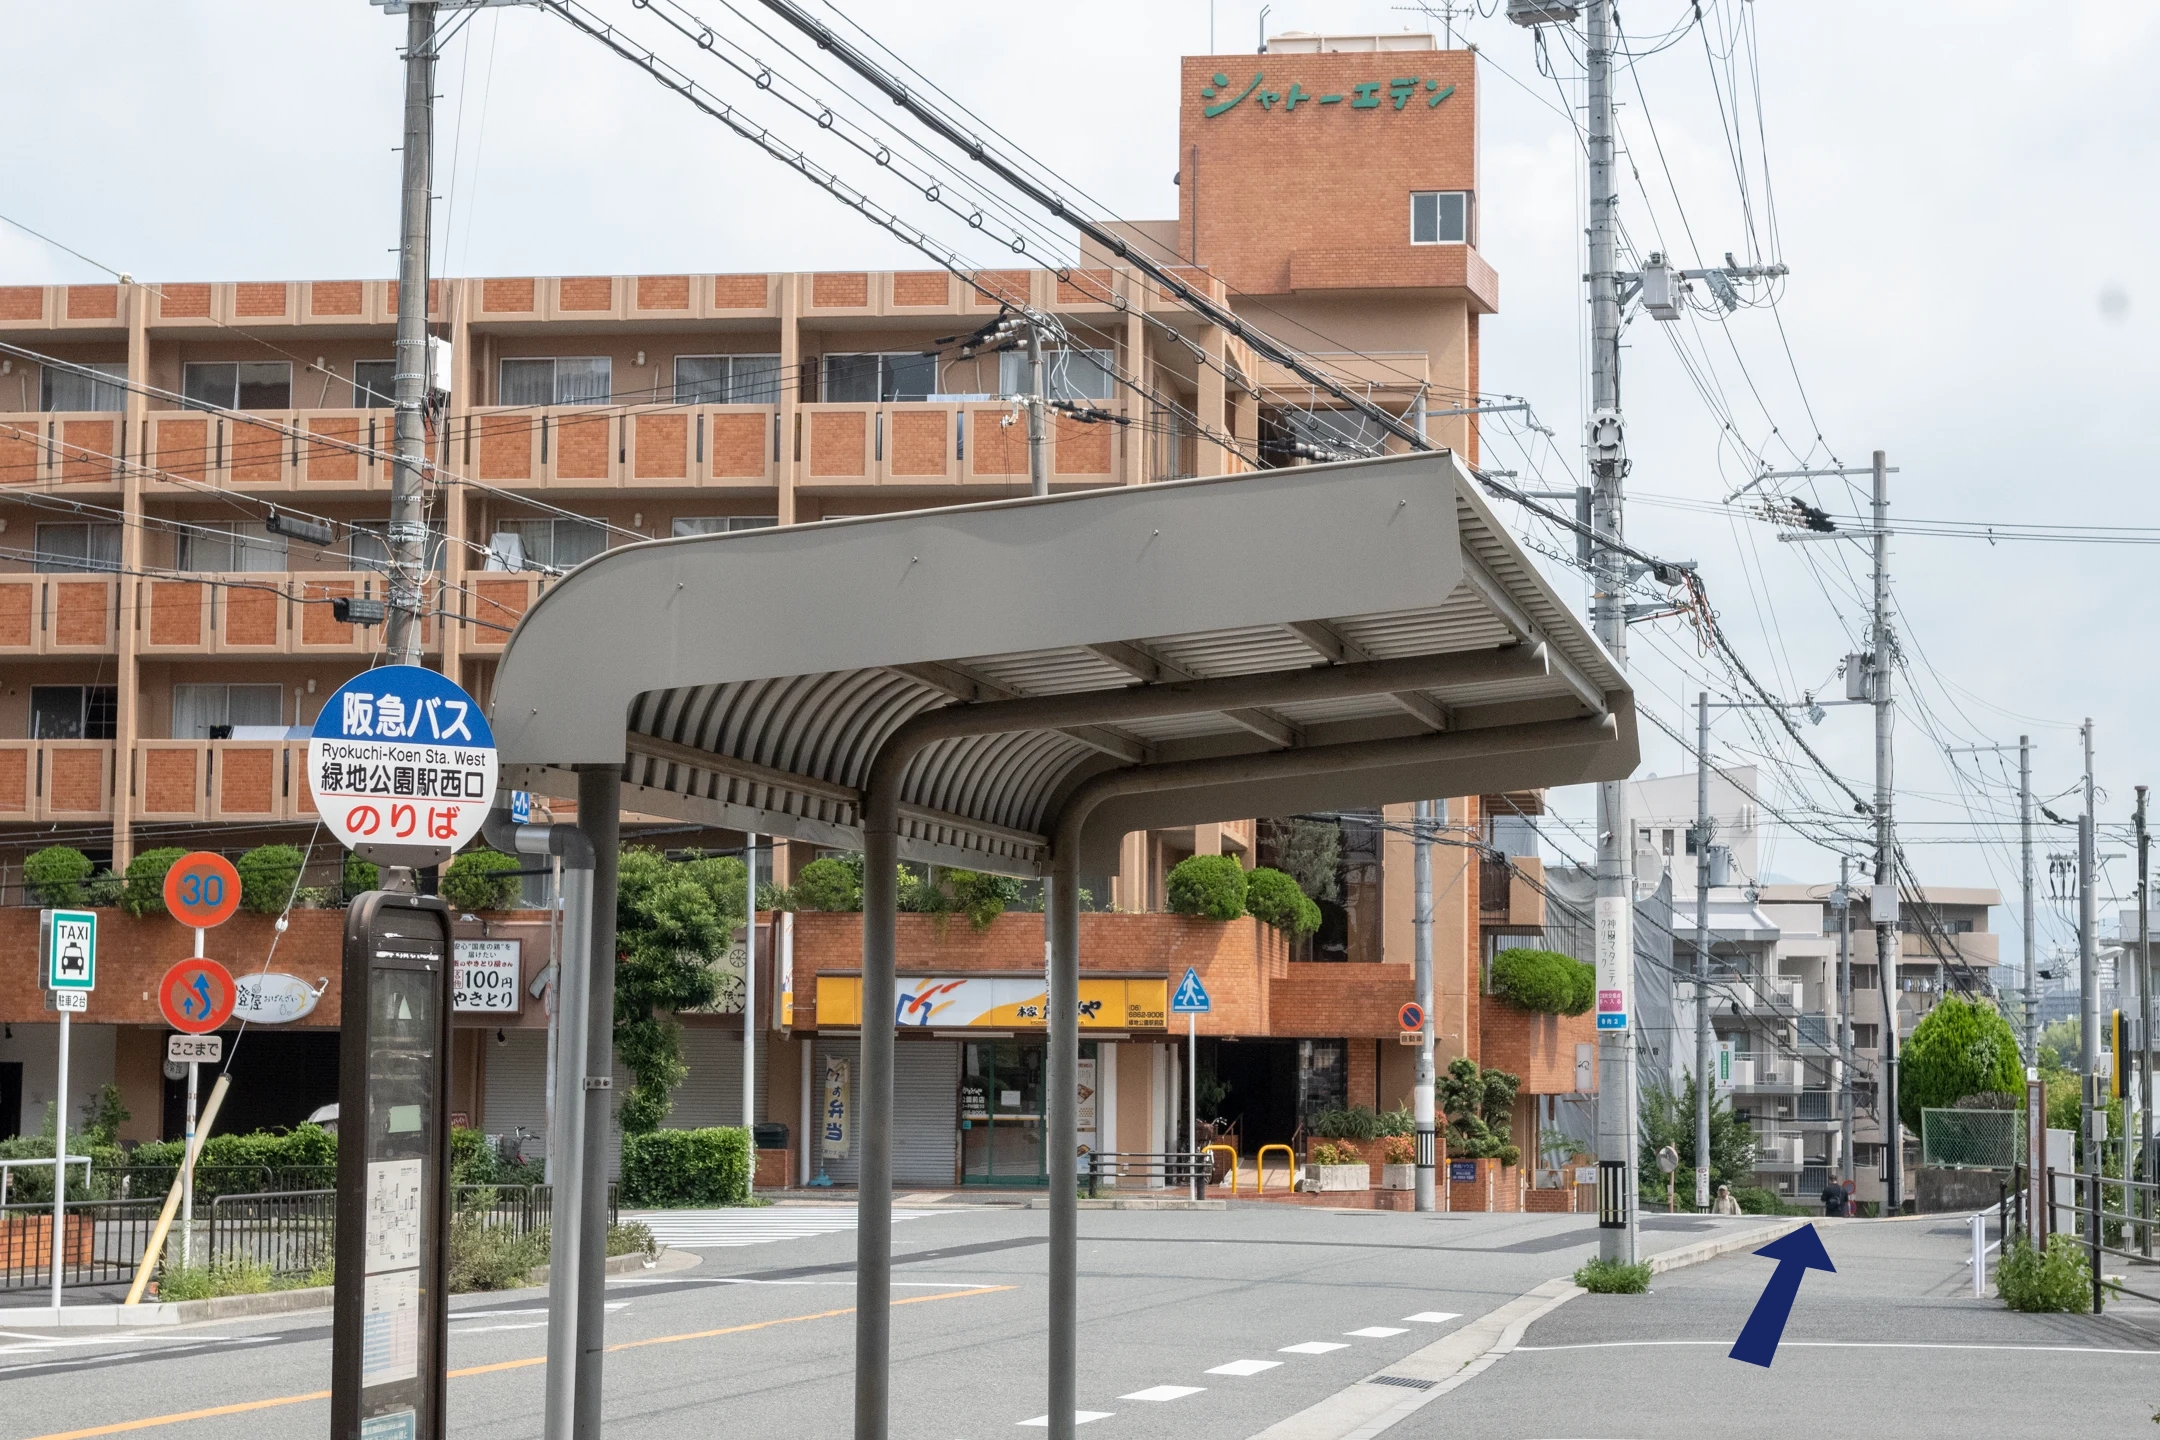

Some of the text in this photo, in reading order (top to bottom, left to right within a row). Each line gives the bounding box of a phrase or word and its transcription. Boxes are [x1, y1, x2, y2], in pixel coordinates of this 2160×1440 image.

[1202, 72, 1455, 118] シャトーエデン
[342, 692, 472, 741] 阪急バス
[322, 743, 486, 767] Ryokuchi-Koen Sta. West
[321, 762, 484, 798] 緑地公園駅西口
[346, 804, 460, 840] のりば
[181, 874, 224, 906] 30
[59, 925, 89, 940] TAXI
[468, 951, 497, 959] 届けたい
[465, 970, 513, 989] 100円
[58, 994, 86, 1008] 駐車2台
[453, 991, 513, 1008] やきとり
[1128, 1004, 1142, 1012] (06)
[1016, 1005, 1038, 1018] 本家
[170, 1042, 219, 1057] ここまで
[825, 1086, 844, 1141] お弁当
